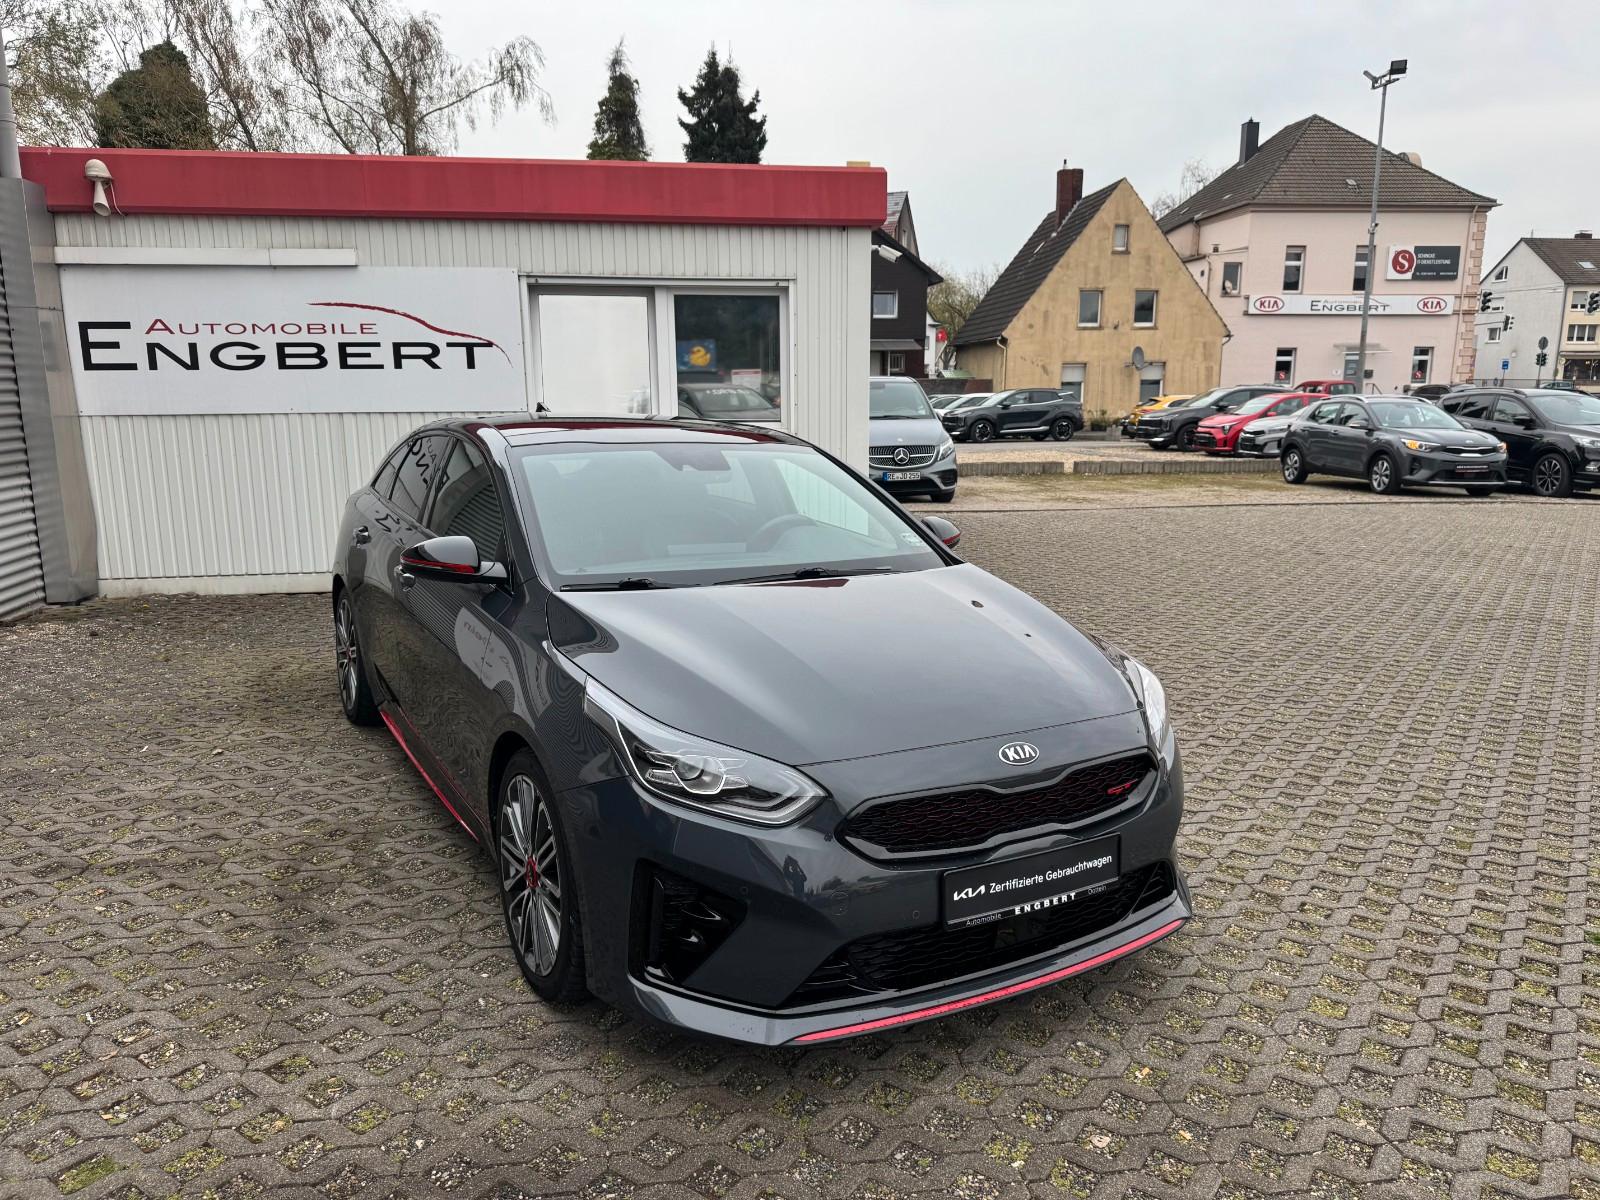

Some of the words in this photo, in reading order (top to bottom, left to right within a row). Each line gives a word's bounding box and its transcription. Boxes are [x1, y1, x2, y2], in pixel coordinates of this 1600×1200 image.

[1258, 298, 1280, 310] KIA
[1310, 299, 1391, 312] ENGBERT
[1422, 299, 1443, 310] KIA
[145, 318, 379, 335] AUTOMOBILE
[78, 320, 494, 371] ENGBERT
[1004, 744, 1036, 762] KIA
[989, 873, 1044, 894] Zertifizierte
[1045, 855, 1113, 882] Gebrauchtwagen
[965, 913, 1002, 927] Automobile
[1014, 892, 1076, 915] ENGBERT
